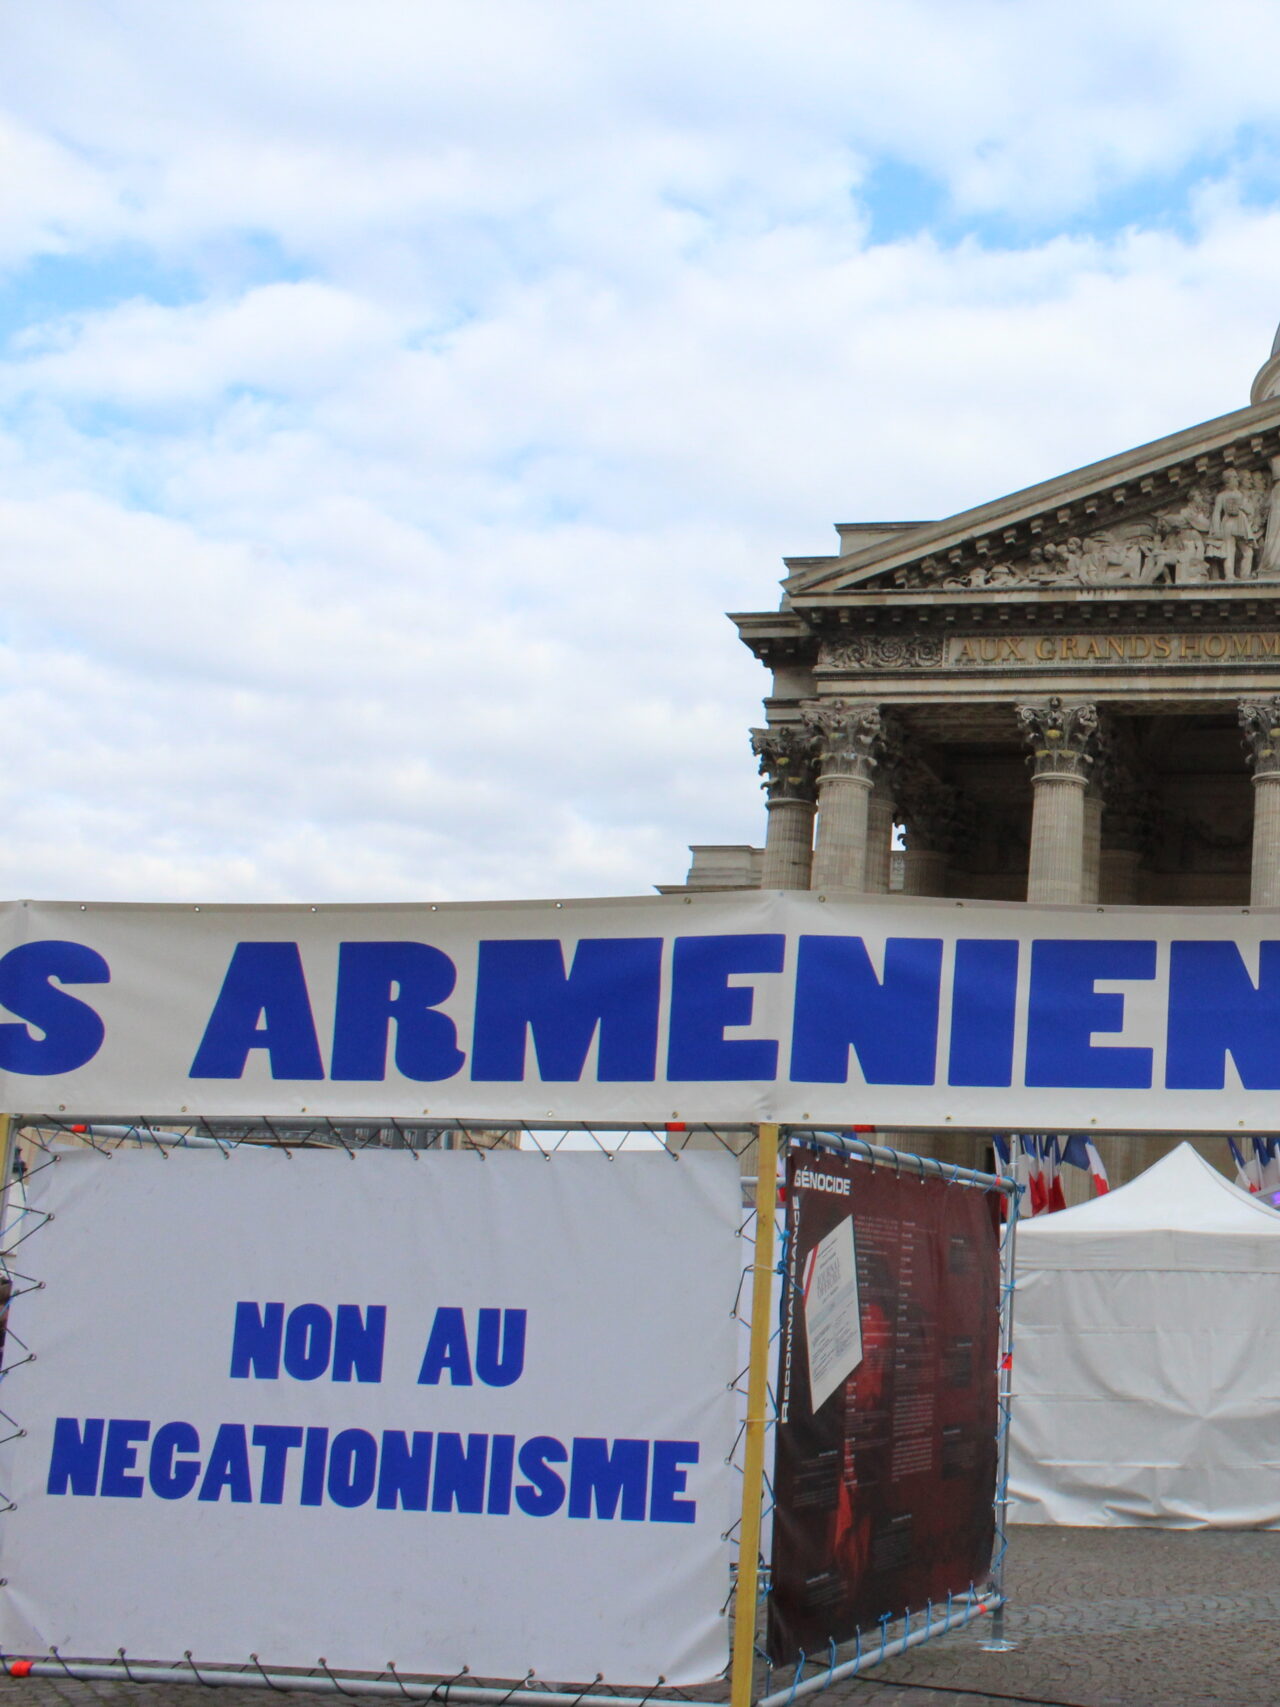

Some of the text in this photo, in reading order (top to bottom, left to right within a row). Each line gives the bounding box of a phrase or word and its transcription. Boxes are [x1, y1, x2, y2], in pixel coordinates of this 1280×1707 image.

[955, 636, 1026, 662] AUX
[1035, 634, 1171, 661] GRANDS
[794, 1165, 852, 1196] GÉNOCIDE
[228, 1300, 528, 1388] NON AU
[46, 1417, 700, 1524] NEGATIONNISME
